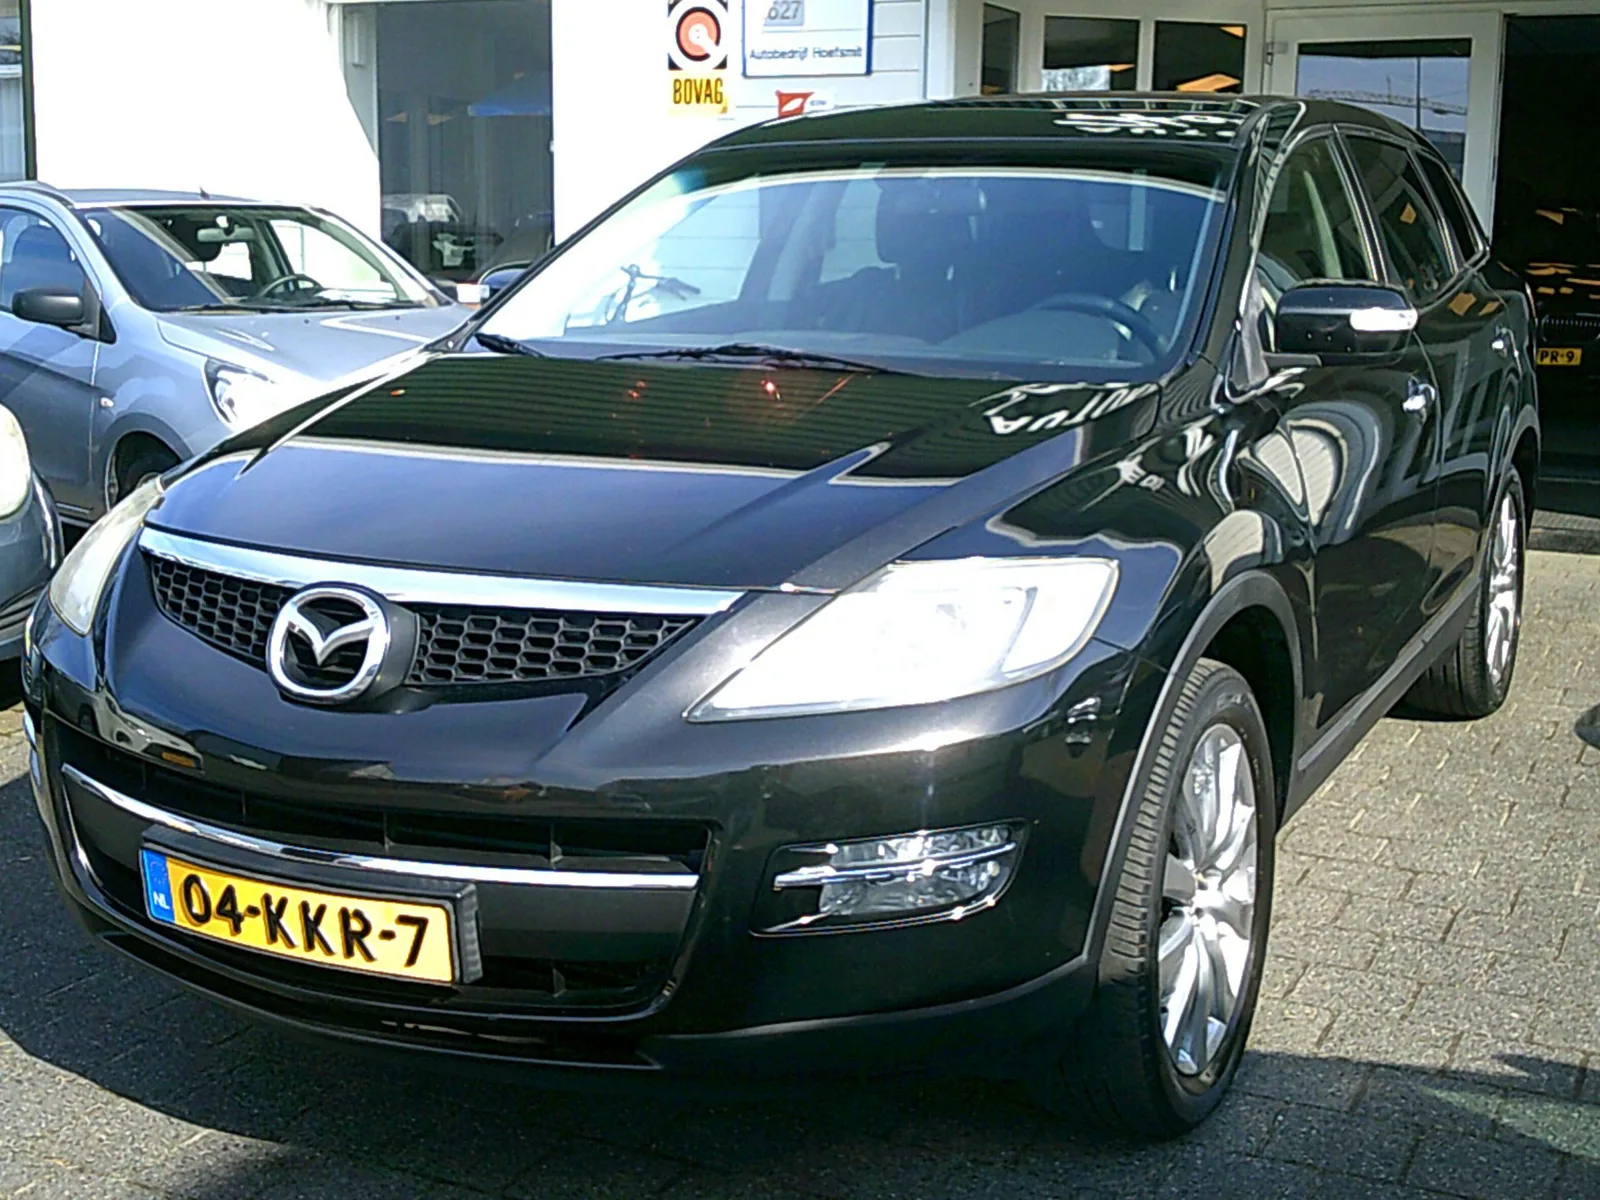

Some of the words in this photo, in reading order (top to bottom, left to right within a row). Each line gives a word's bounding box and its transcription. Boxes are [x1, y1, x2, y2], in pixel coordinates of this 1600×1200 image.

[673, 77, 723, 104] BOVAG
[153, 891, 171, 910] NL
[182, 874, 429, 968] 04-KKR-7
